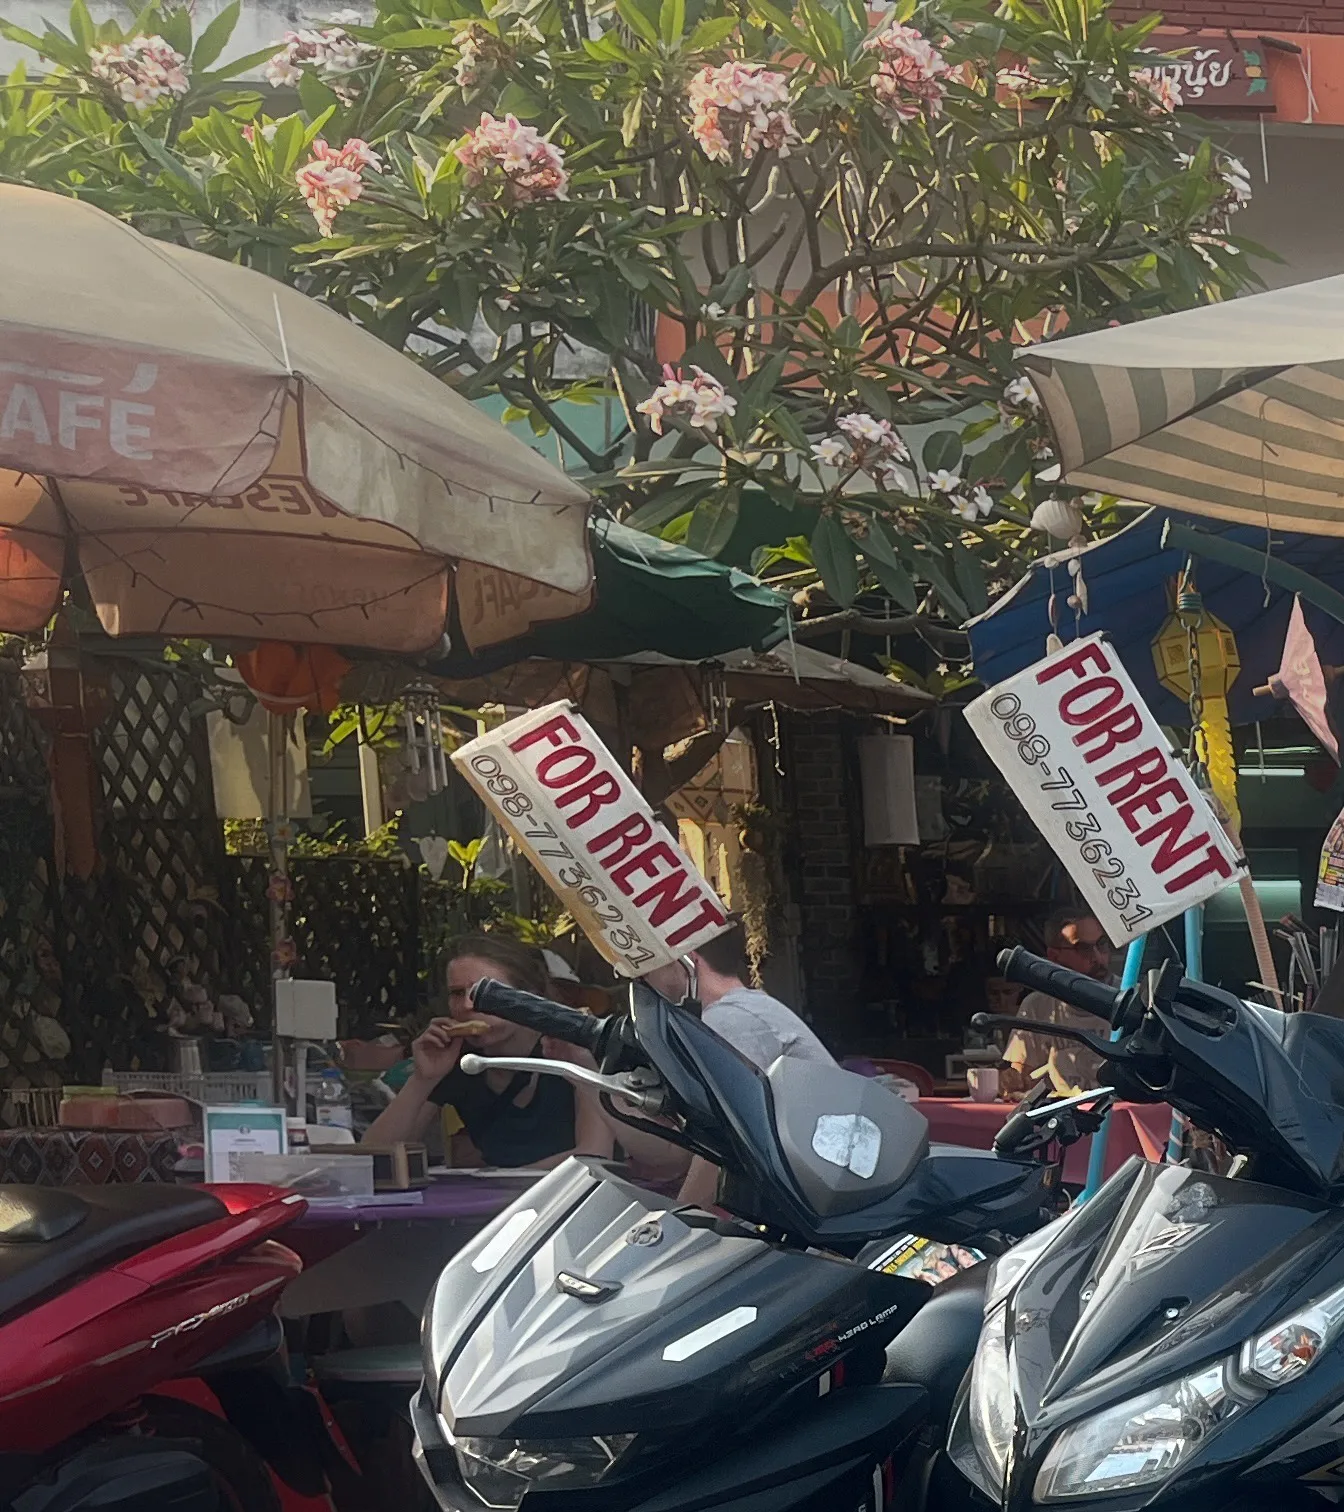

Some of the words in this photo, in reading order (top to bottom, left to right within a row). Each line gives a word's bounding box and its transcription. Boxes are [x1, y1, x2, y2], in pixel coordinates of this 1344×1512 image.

[470, 754, 656, 970] 098-7736231
[508, 714, 621, 829] FOR
[586, 811, 727, 948] RENT
[990, 692, 1154, 932] 098-7736231
[1035, 642, 1143, 764] FOR
[1095, 746, 1233, 894] RENT
